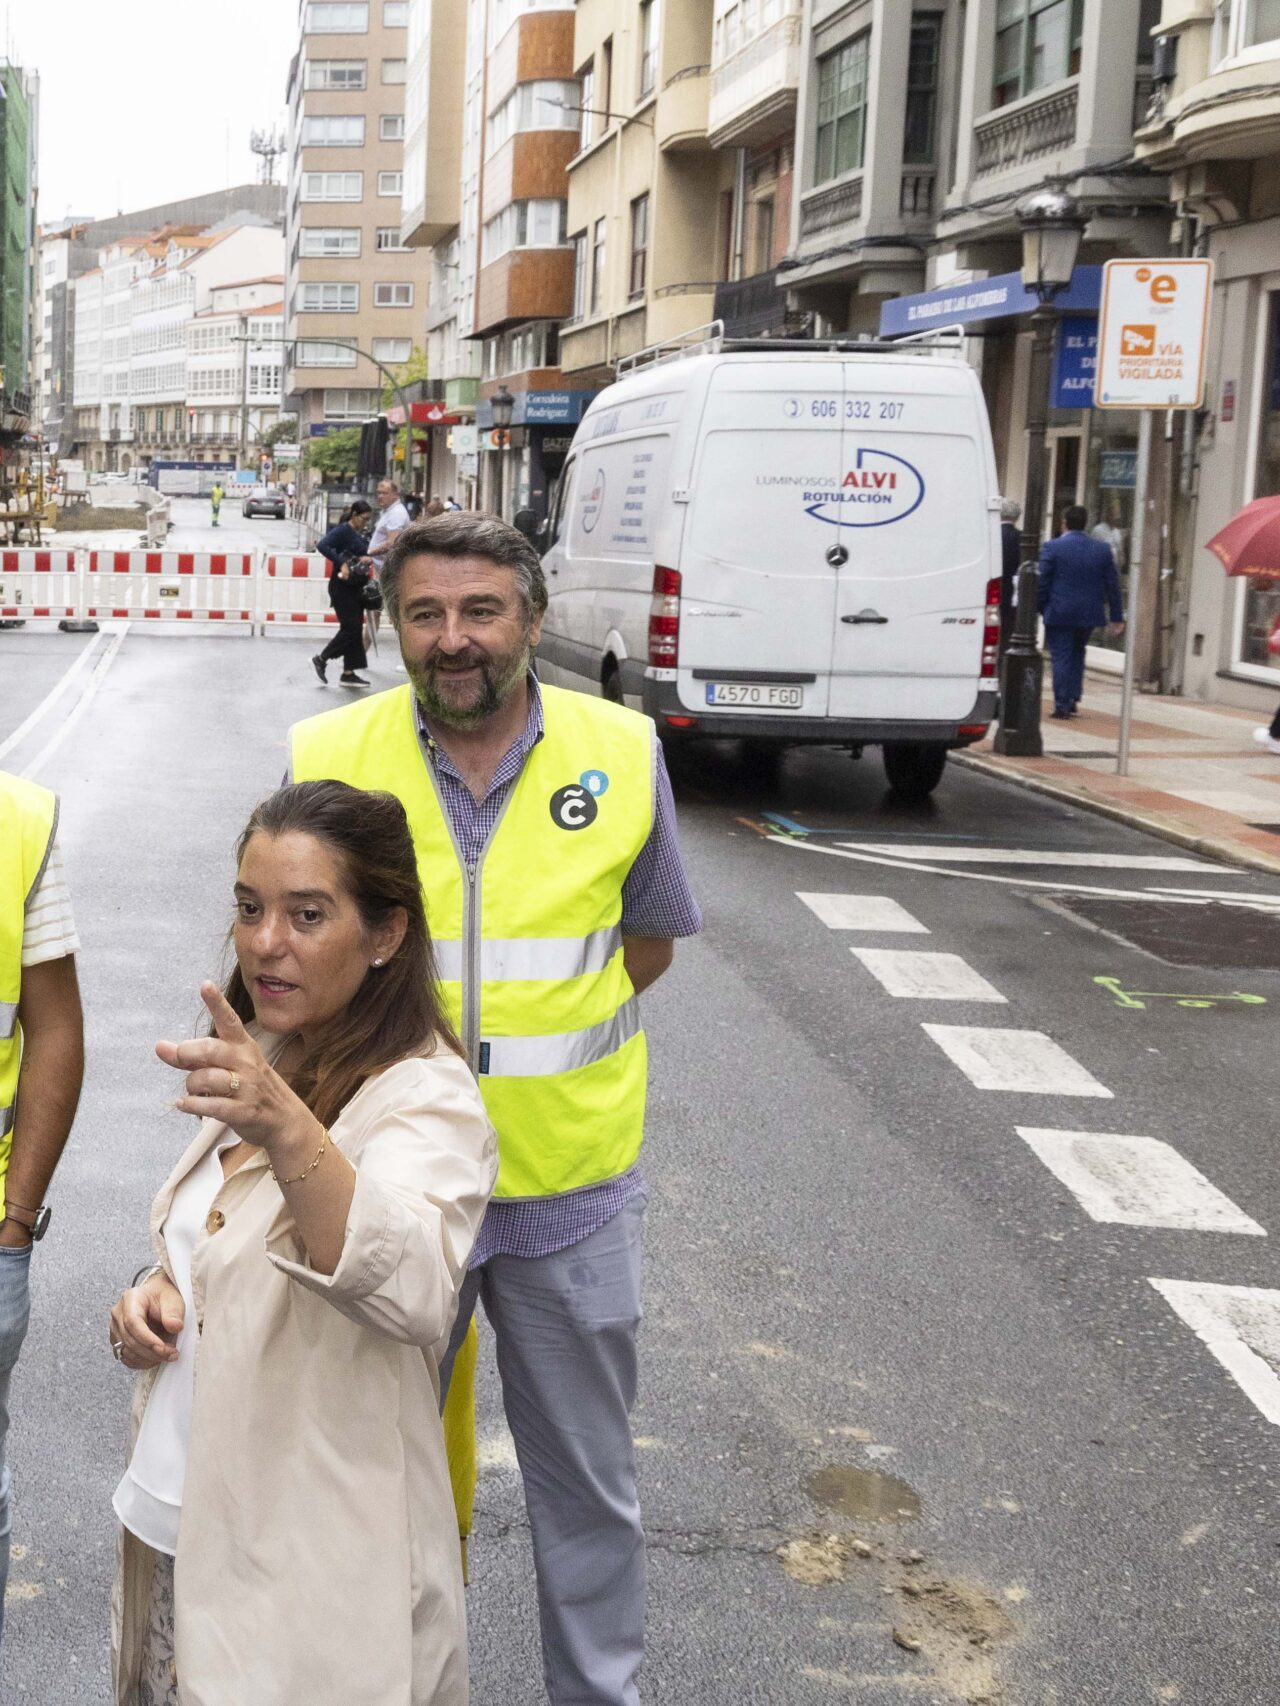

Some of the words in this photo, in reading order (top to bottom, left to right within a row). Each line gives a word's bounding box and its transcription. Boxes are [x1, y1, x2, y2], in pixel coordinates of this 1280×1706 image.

[1066, 336, 1085, 348] EL
[1159, 341, 1183, 356] VÍA
[1119, 358, 1184, 367] PRIORITARIA
[1120, 368, 1183, 380] VIGILADA
[811, 400, 837, 417] 606
[846, 401, 870, 418] 332
[879, 402, 904, 419] 207
[756, 475, 836, 487] LUMINOSOS
[841, 471, 897, 489] ALVI
[803, 491, 892, 504] ROTULACIÓN
[718, 686, 761, 702] 4570
[768, 688, 799, 704] FGD
